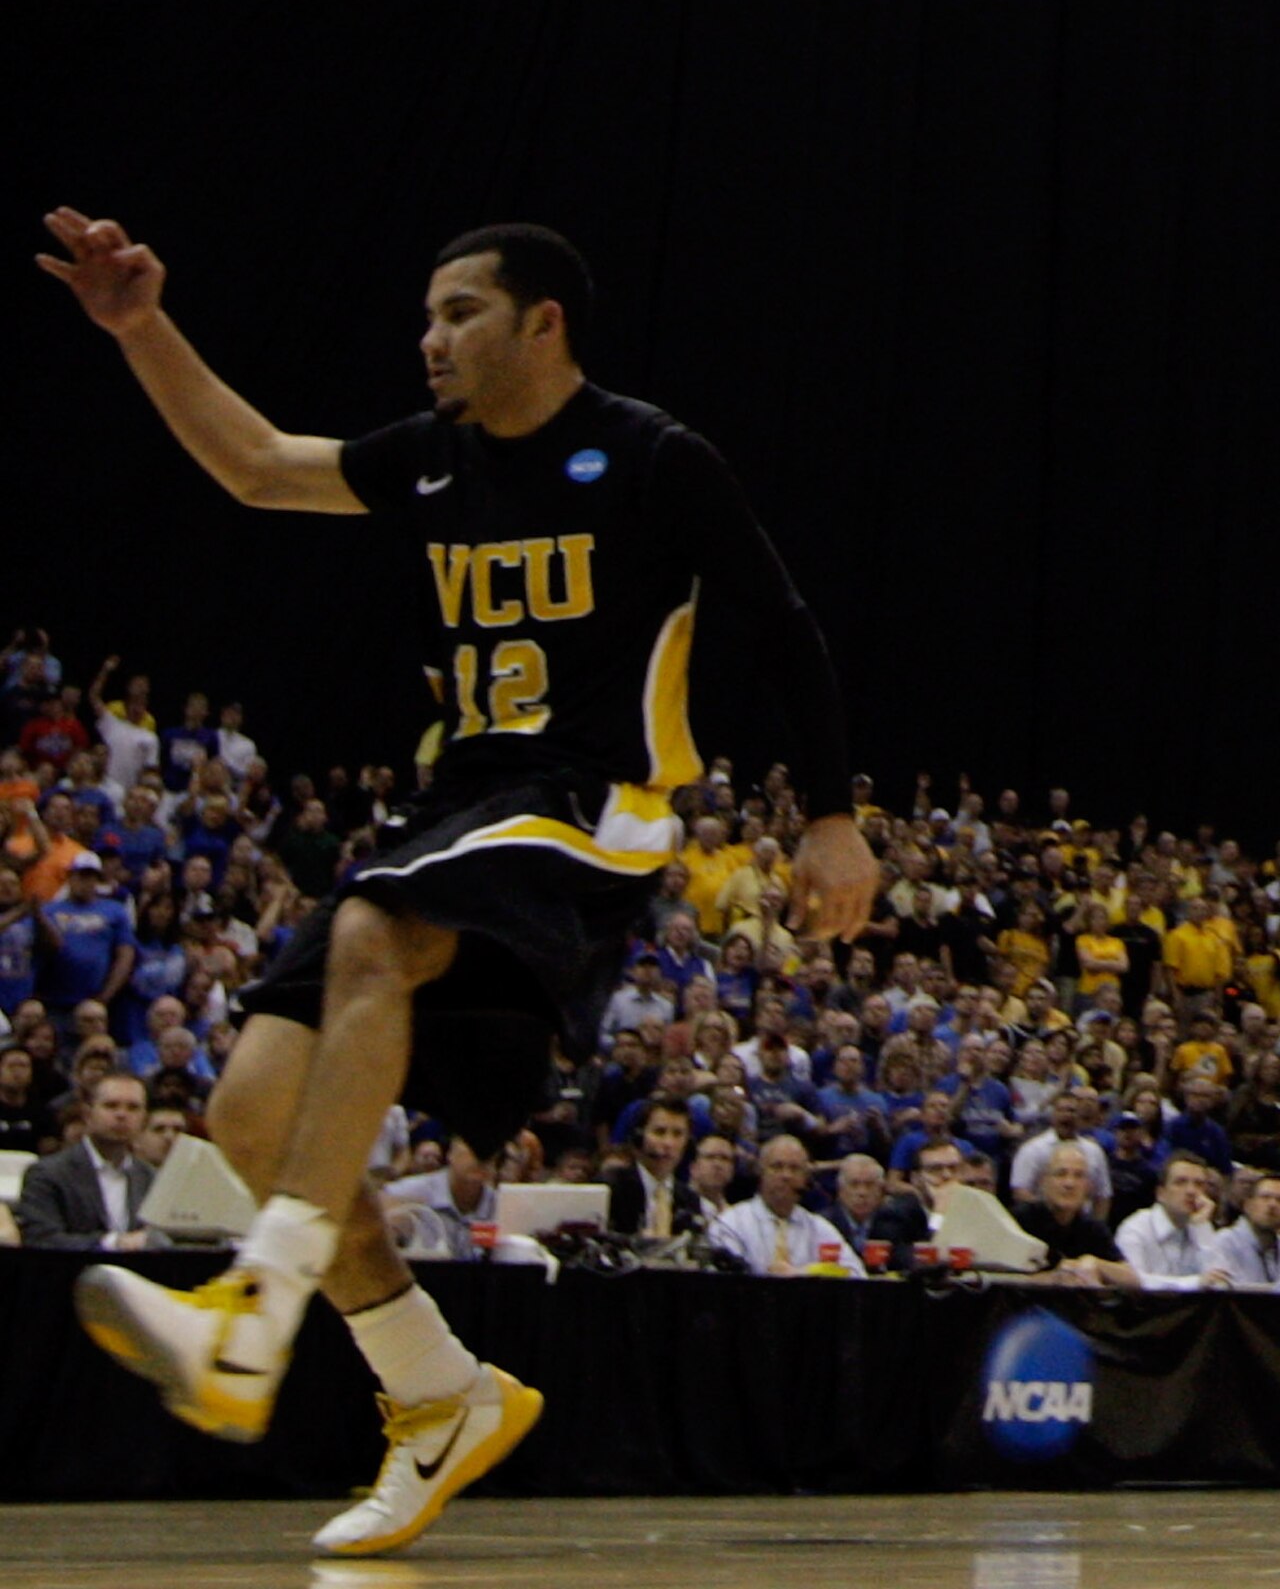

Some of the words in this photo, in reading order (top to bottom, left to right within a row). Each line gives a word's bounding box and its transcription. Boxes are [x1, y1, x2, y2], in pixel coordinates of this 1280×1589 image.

[427, 533, 596, 628] VCU
[452, 639, 552, 741] 12
[981, 1380, 1094, 1423] NCAA
